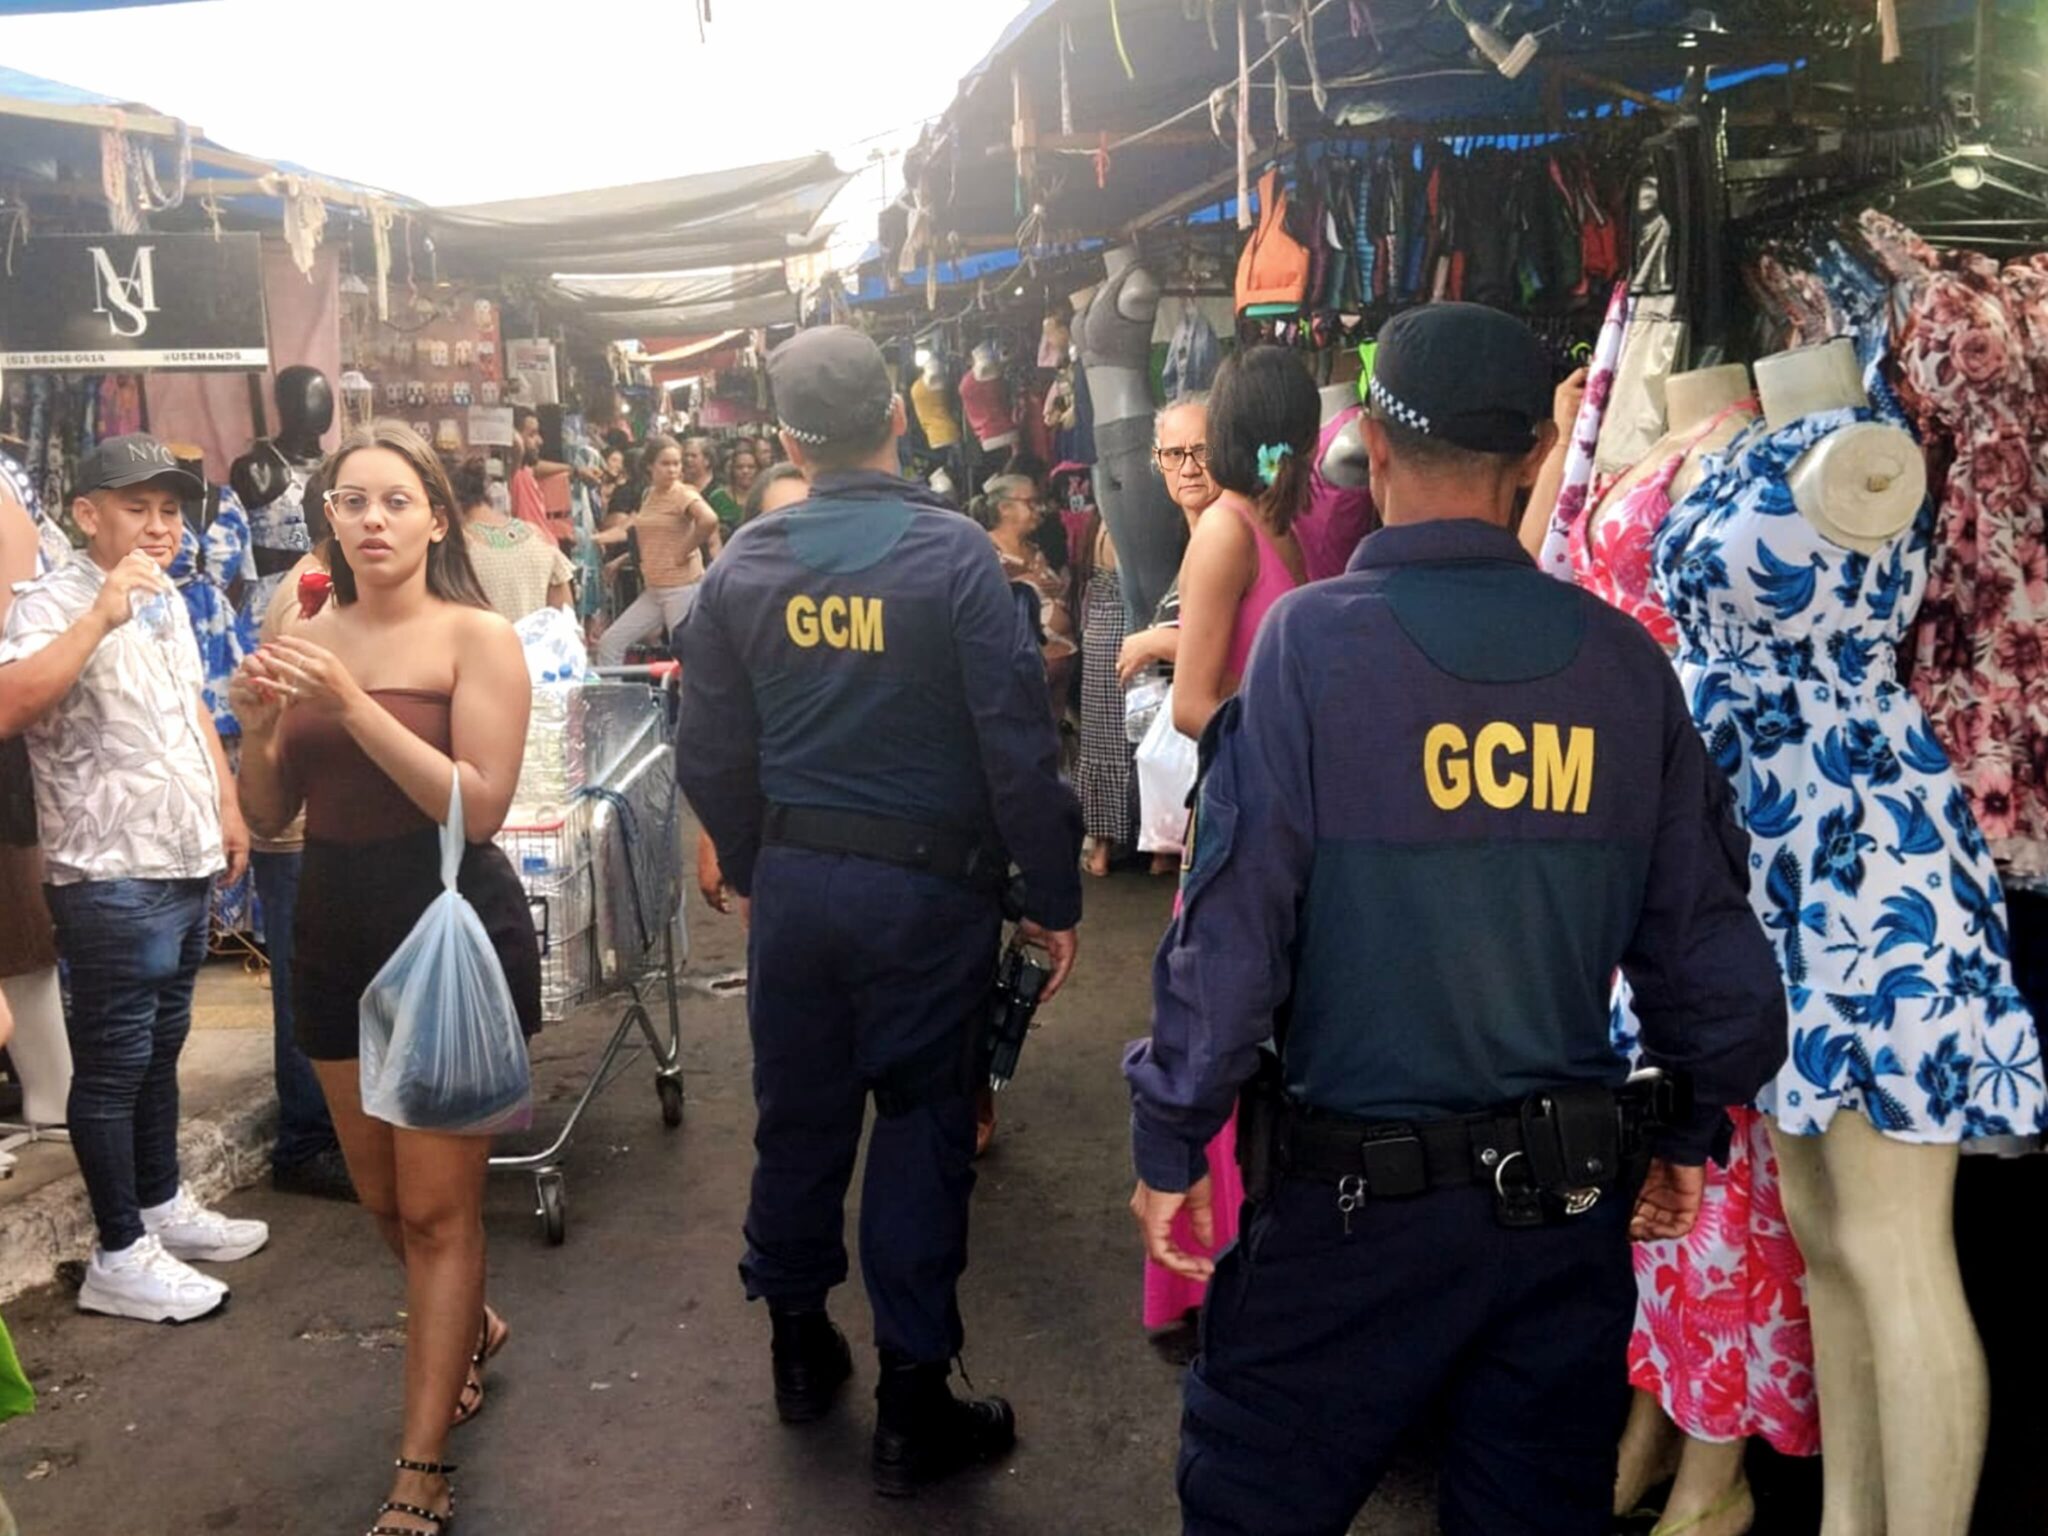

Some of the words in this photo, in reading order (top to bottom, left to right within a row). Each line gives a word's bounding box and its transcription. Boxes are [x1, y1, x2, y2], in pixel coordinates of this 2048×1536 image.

[128, 441, 176, 466] NYC
[785, 594, 885, 652] GCM
[1423, 721, 1595, 814] GCM
